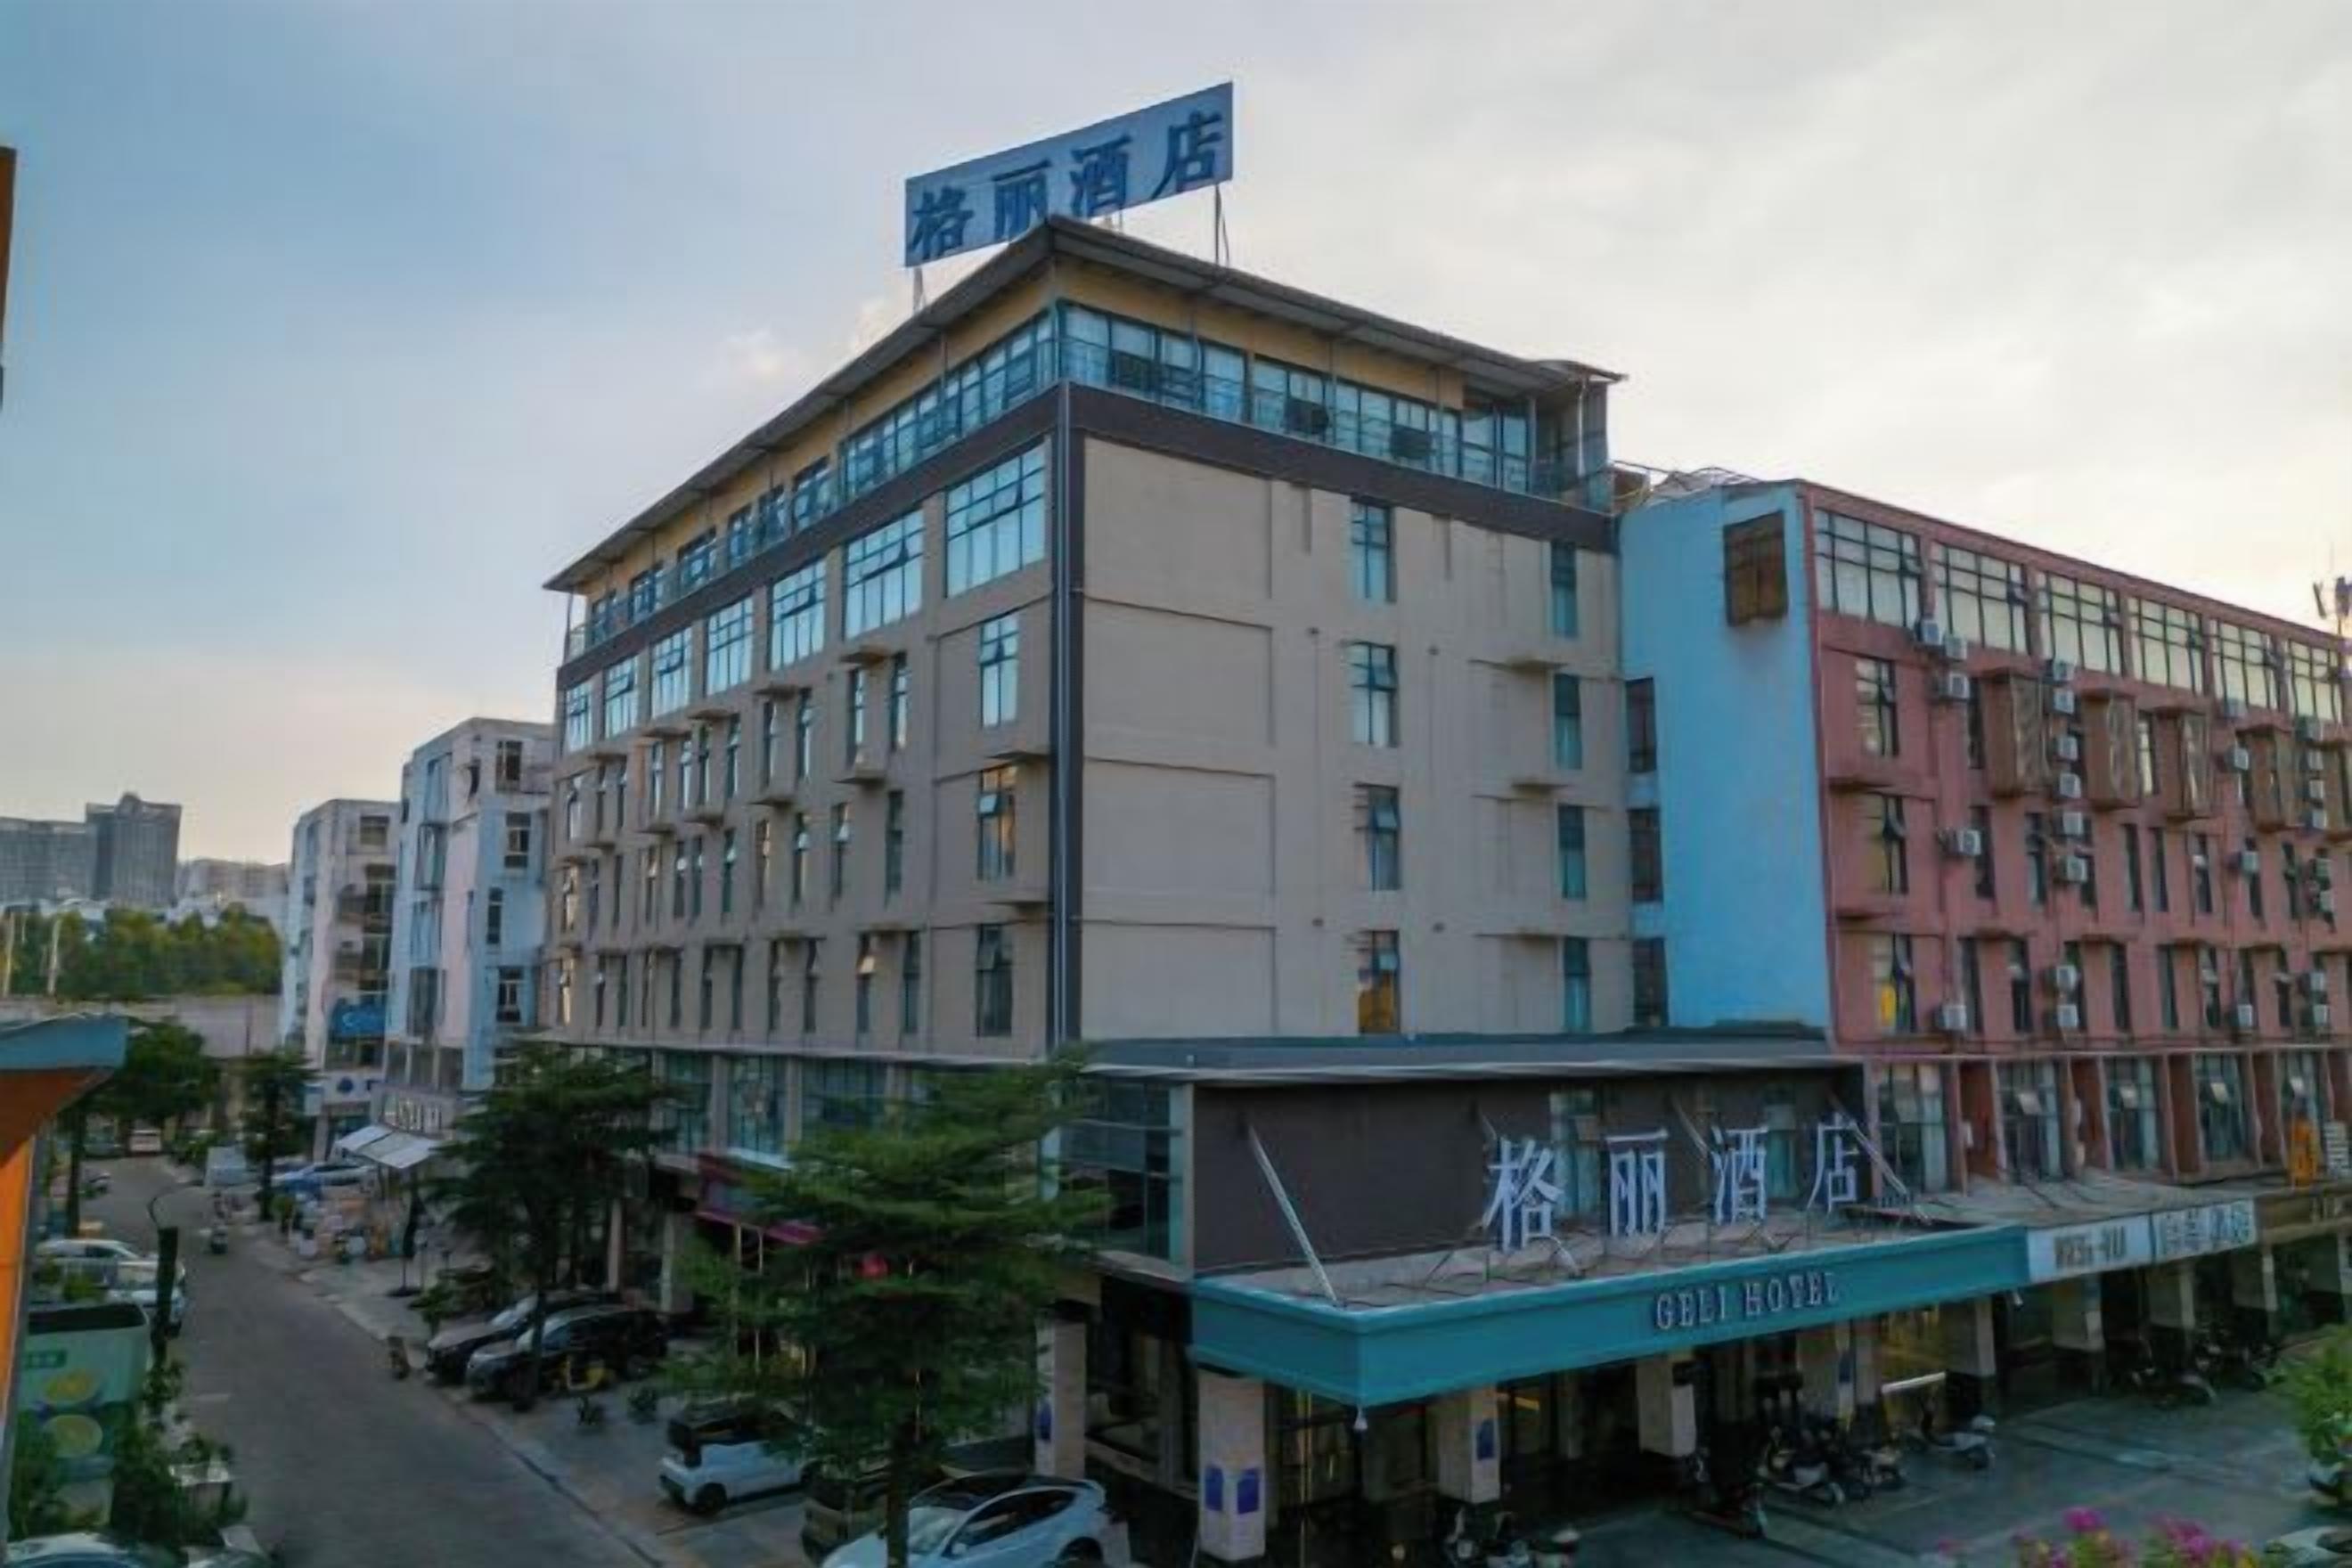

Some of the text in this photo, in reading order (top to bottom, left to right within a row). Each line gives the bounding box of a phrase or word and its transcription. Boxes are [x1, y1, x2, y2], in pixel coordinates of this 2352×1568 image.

[907, 109, 1223, 261] 格丽酒店
[1482, 1110, 1859, 1254] 格丽酒店
[1655, 1270, 1840, 1330] GELI HOTEL
